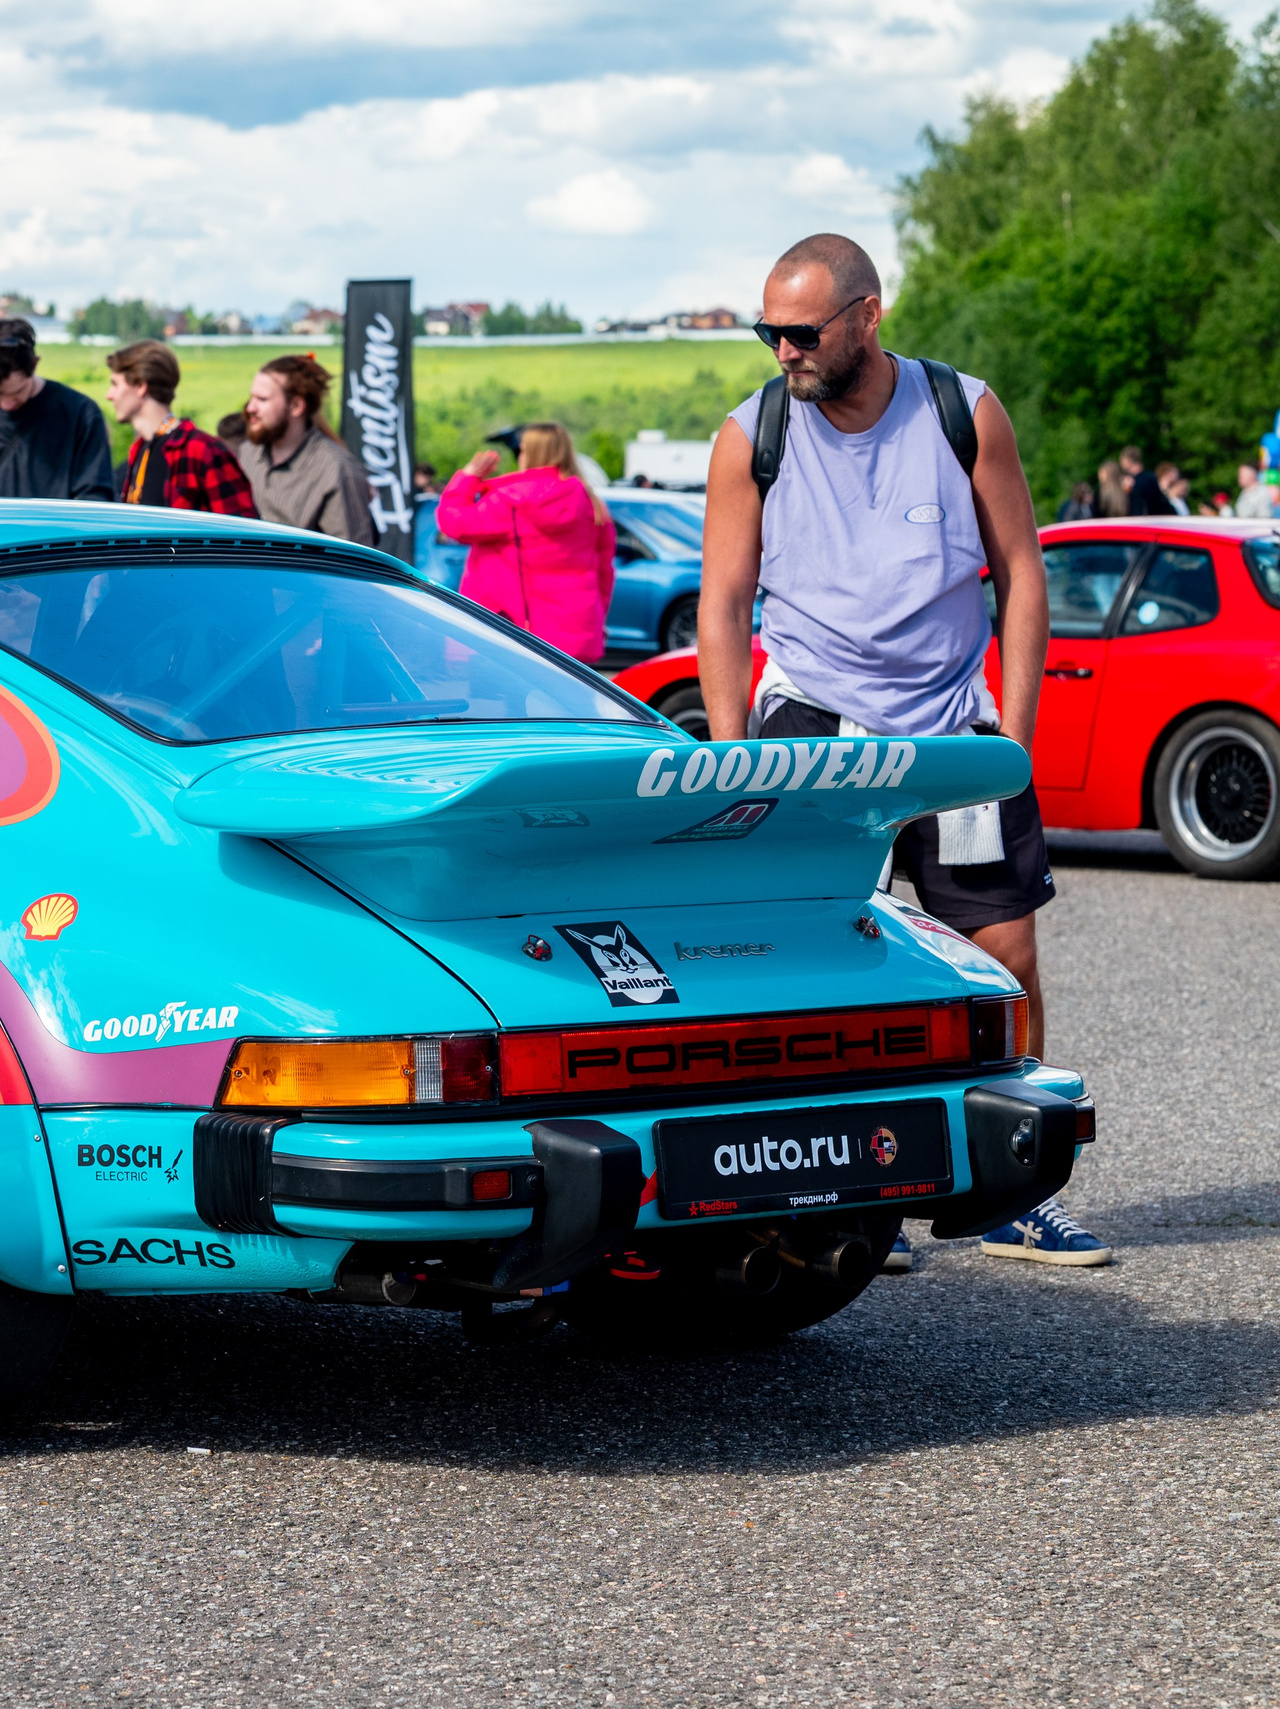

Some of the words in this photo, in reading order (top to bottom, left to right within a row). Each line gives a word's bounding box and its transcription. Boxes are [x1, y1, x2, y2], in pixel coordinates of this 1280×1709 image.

[637, 741, 916, 798] GOODYEAR
[674, 941, 776, 961] kremer
[604, 976, 672, 990] Vaillant
[83, 1004, 240, 1043] GOODYEAR
[567, 1026, 926, 1078] PORSCHE
[77, 1144, 162, 1168] BOSCH
[714, 1134, 850, 1177] auto.ru
[95, 1170, 148, 1181] ELECTRIC
[699, 1200, 738, 1212] RedStars
[789, 1191, 839, 1207] трекдни.рф
[72, 1238, 236, 1269] SACHS
